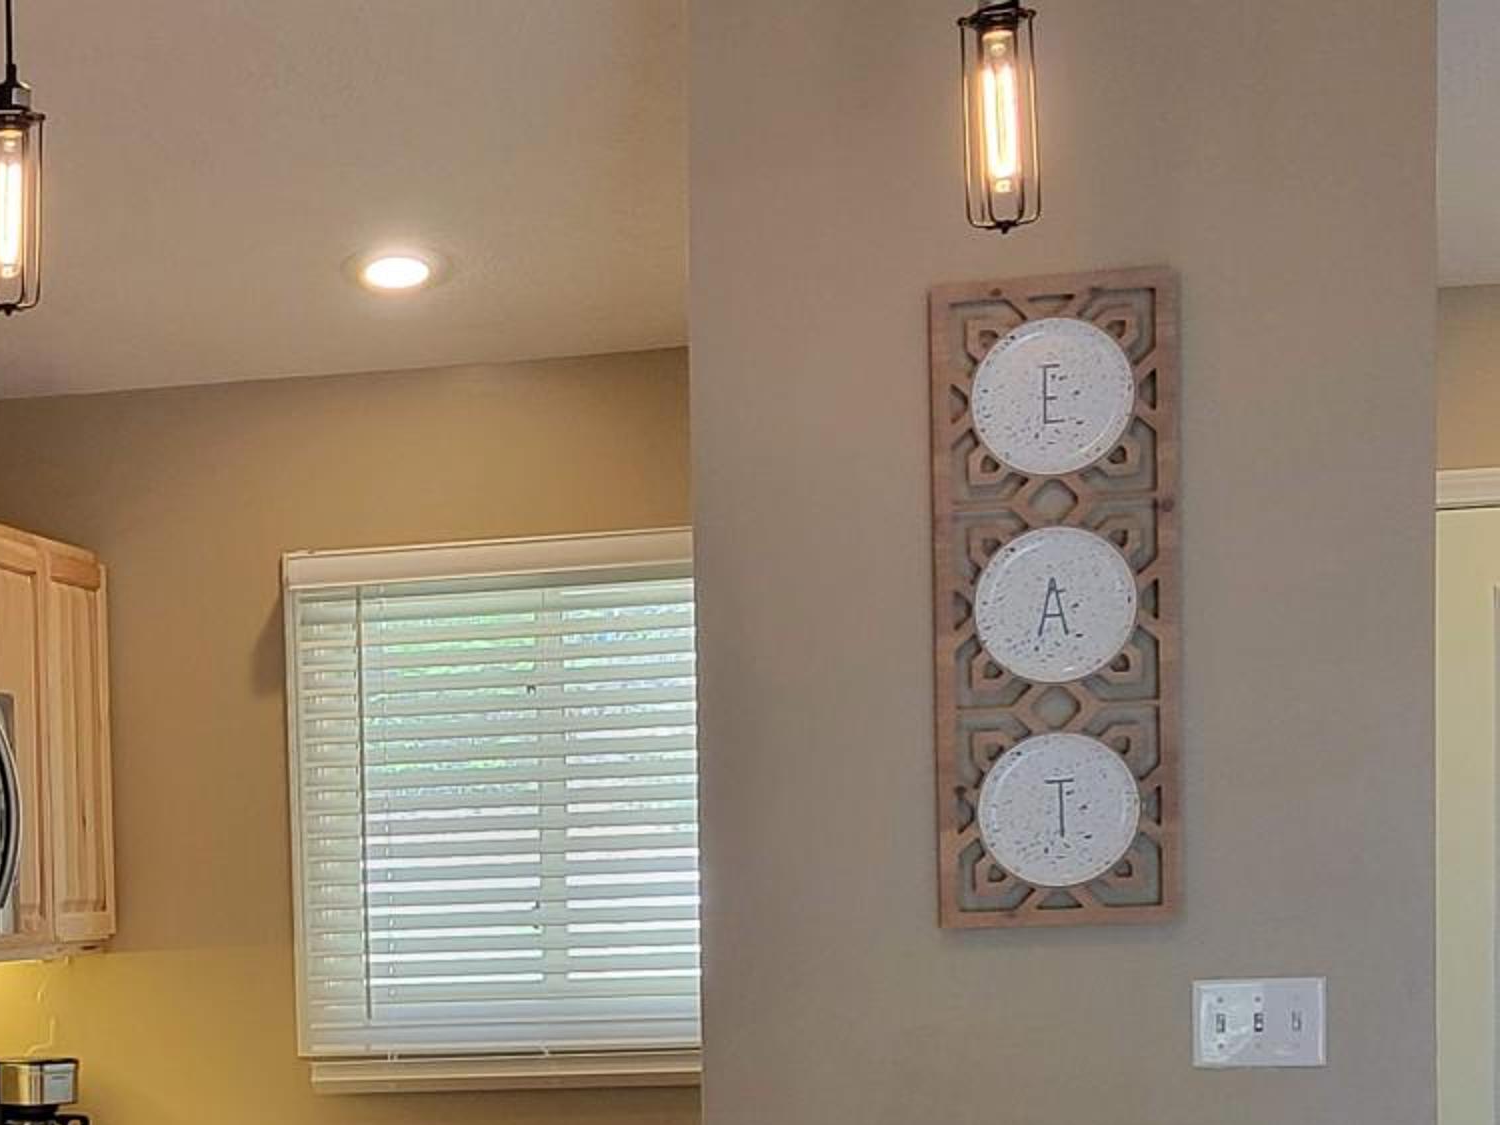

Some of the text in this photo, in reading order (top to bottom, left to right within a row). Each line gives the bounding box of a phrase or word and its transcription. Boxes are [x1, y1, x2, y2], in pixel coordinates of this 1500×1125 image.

[1039, 364, 1065, 425] E
[1038, 576, 1070, 637] A
[1045, 778, 1075, 838] T
